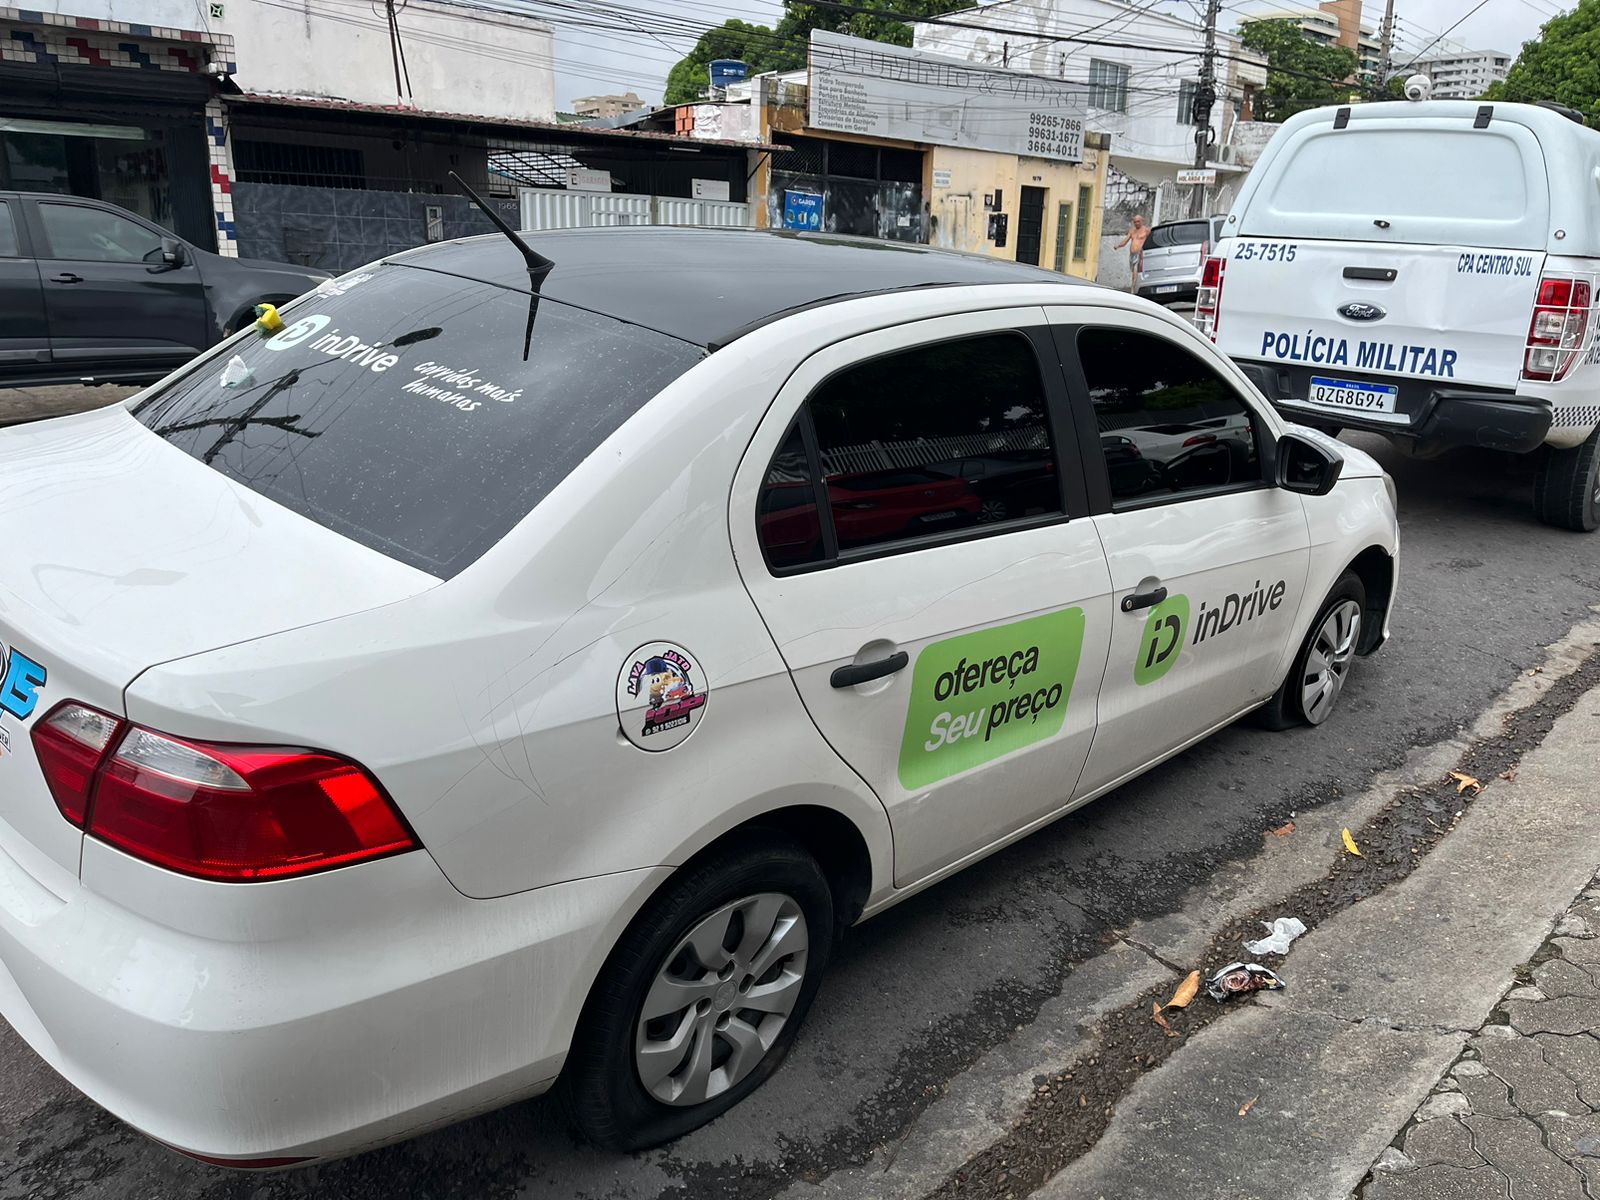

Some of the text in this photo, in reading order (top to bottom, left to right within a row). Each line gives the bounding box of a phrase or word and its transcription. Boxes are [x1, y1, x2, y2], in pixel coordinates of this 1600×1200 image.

[1029, 112, 1081, 132] 99265-7866
[1028, 126, 1080, 145] 99631-1677
[1234, 242, 1298, 262] 25-7515
[1457, 253, 1533, 277] CPA CENTRO SUL
[1345, 303, 1375, 318] Ford
[308, 328, 399, 373] inDrive
[1260, 329, 1458, 378] POLÍCIA MILITAR
[401, 375, 482, 411] humanas
[1316, 386, 1385, 409] QZG8G94
[1191, 579, 1286, 645] inDrive
[663, 650, 691, 671] JATO
[933, 645, 1040, 702] ofereça
[924, 682, 1063, 752] Seu preço
